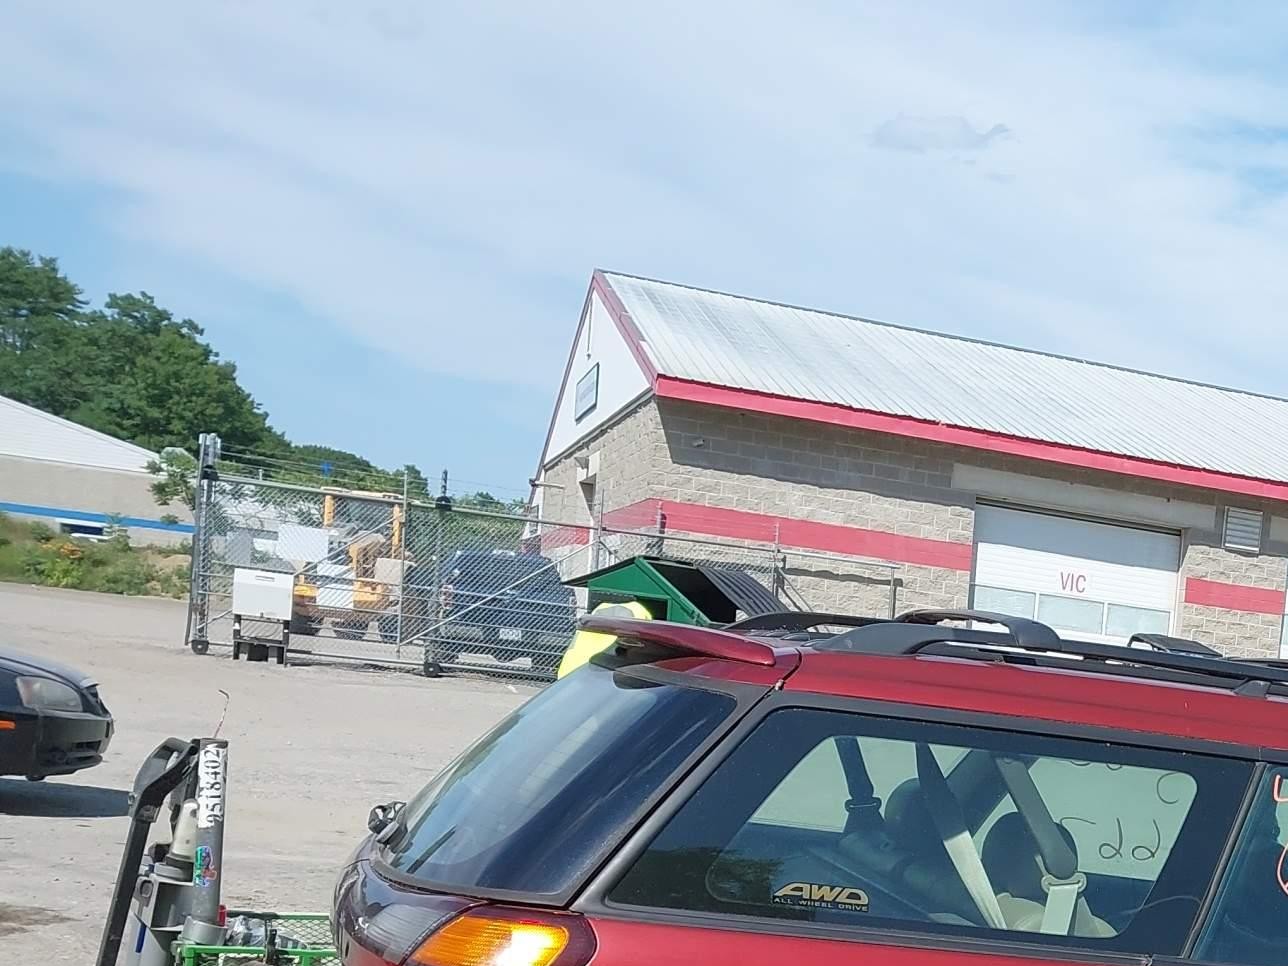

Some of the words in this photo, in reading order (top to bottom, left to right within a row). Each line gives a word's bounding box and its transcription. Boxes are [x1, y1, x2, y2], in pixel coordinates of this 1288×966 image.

[1060, 571, 1087, 593] VIC
[773, 882, 869, 905] AWD
[773, 897, 793, 905] ALL
[799, 900, 834, 909] WHEEL
[838, 903, 868, 912] DRIVE
